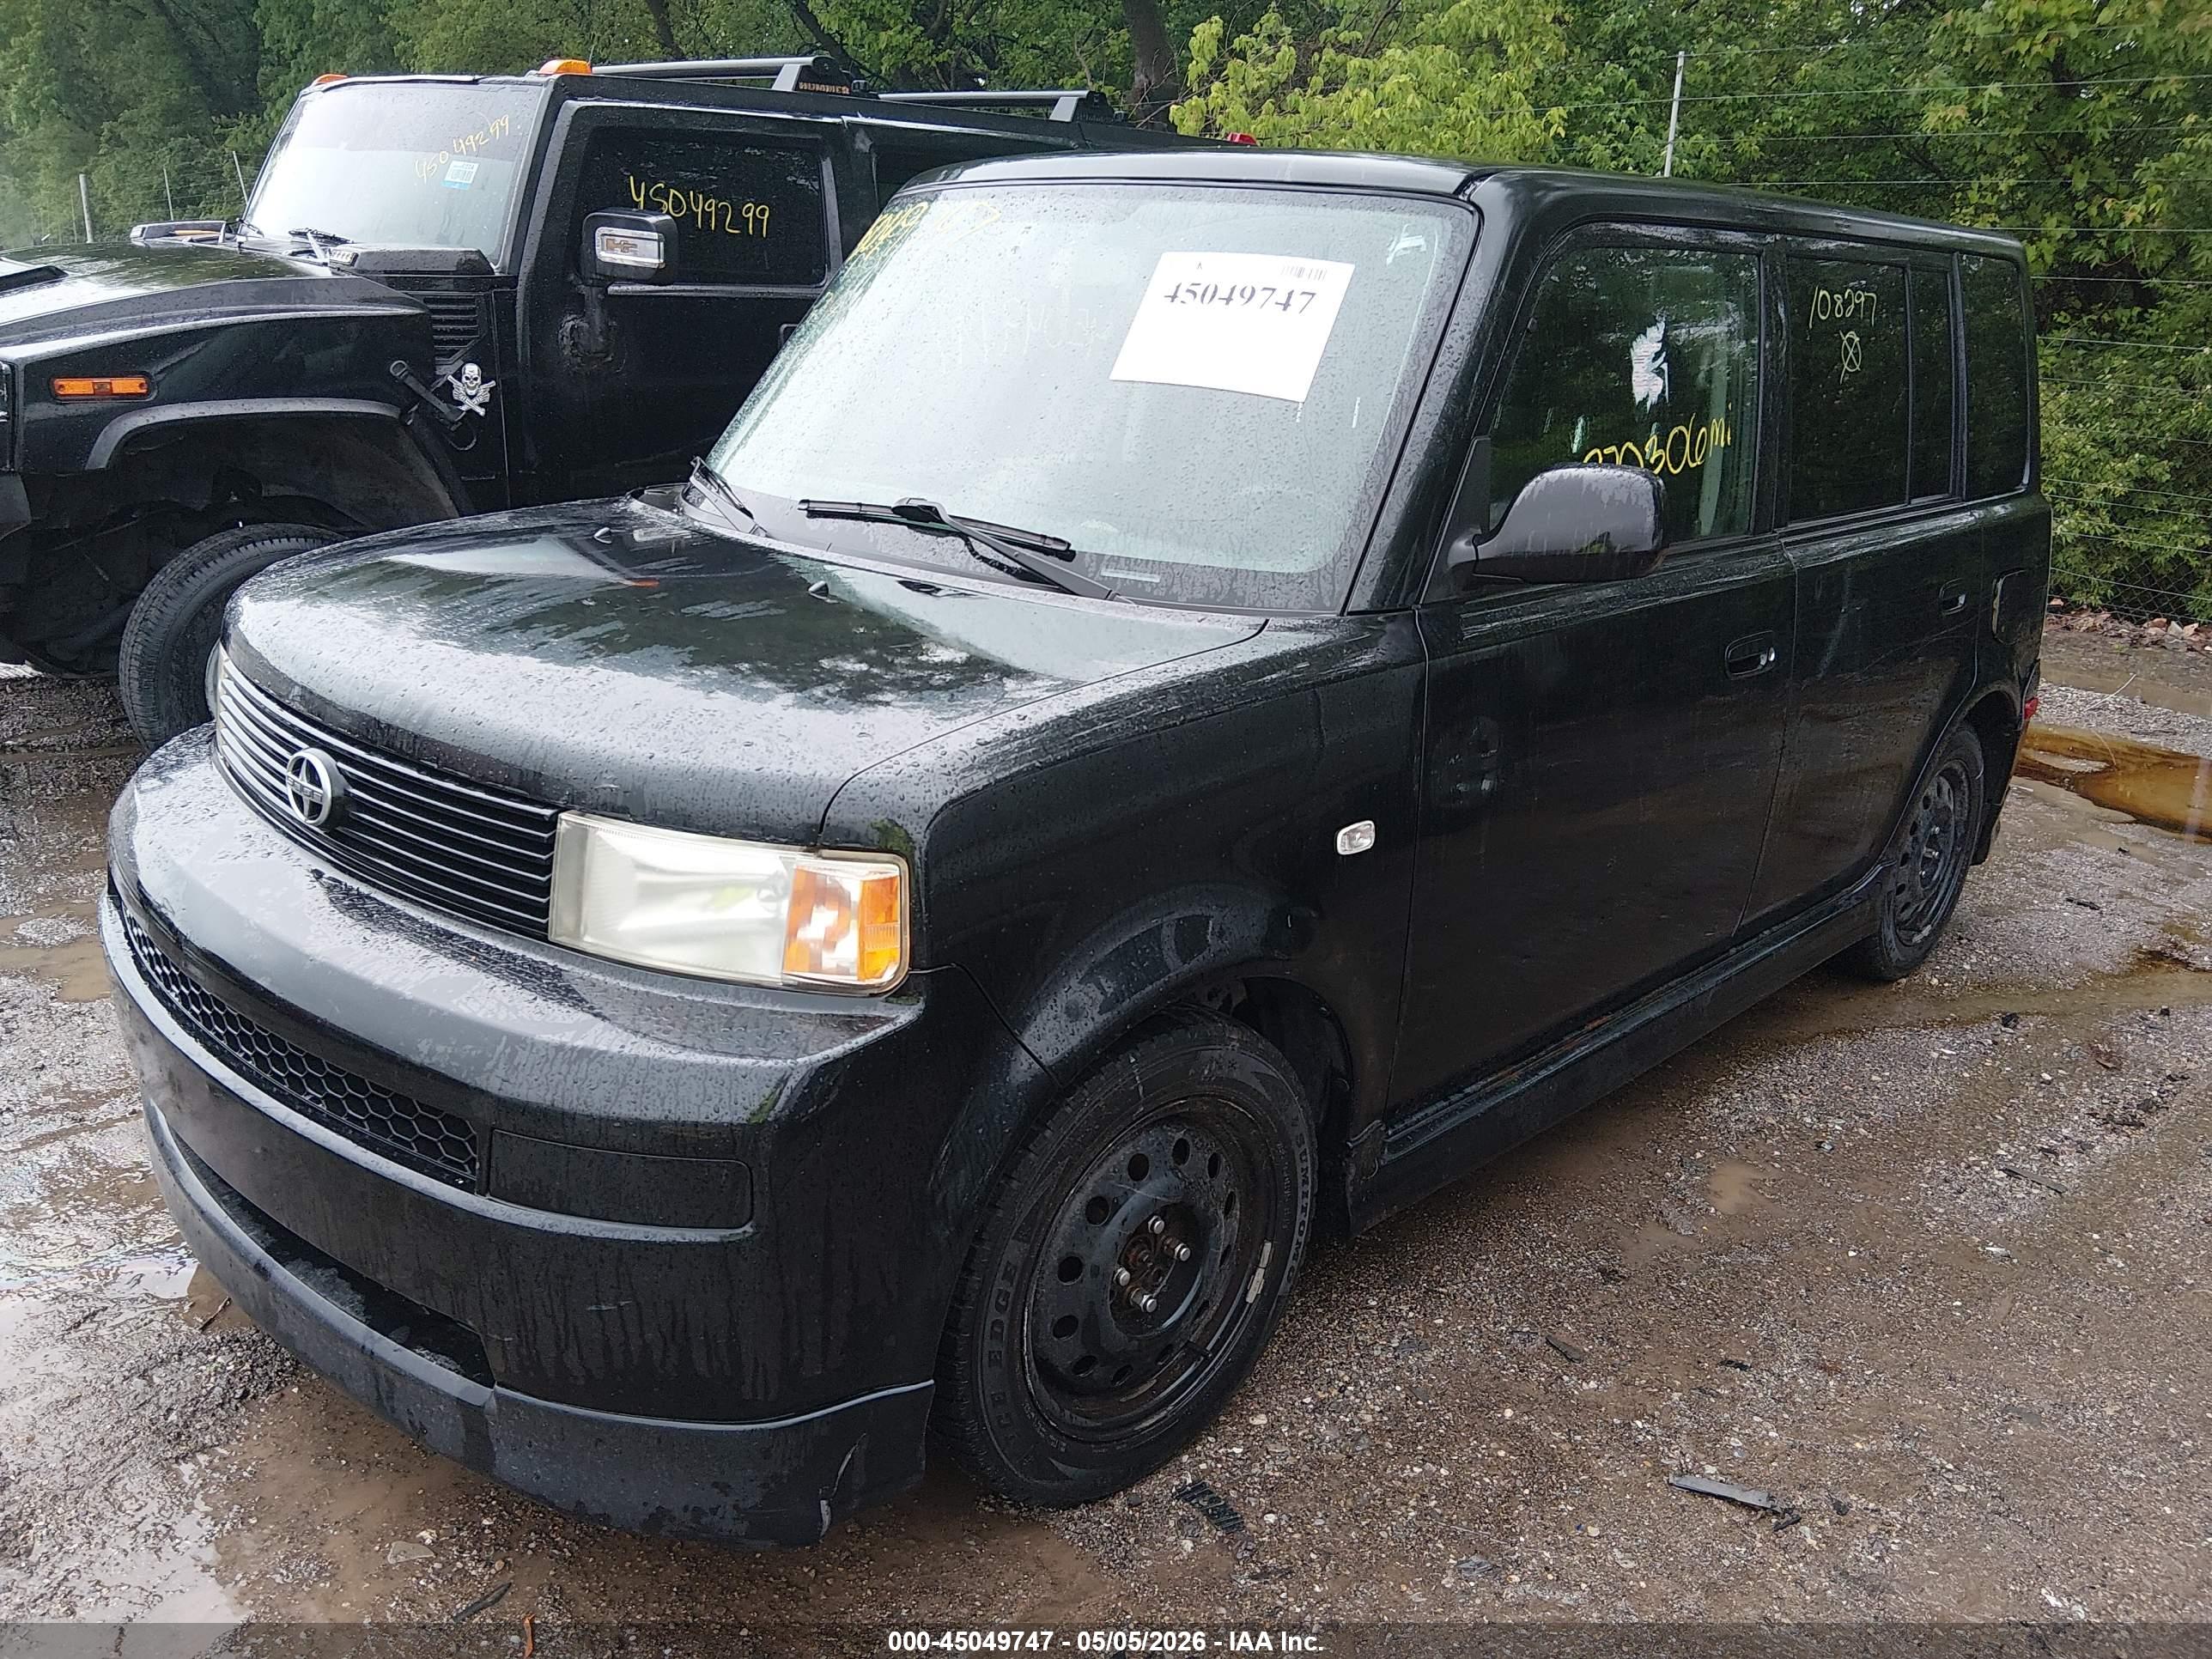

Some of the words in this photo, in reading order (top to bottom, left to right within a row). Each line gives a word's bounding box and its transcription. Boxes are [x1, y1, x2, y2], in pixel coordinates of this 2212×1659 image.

[799, 82, 850, 94] HUMMER
[1164, 282, 1316, 314] 45049747
[1808, 284, 1877, 329] 108297
[988, 1261, 1018, 1369] EDGE
